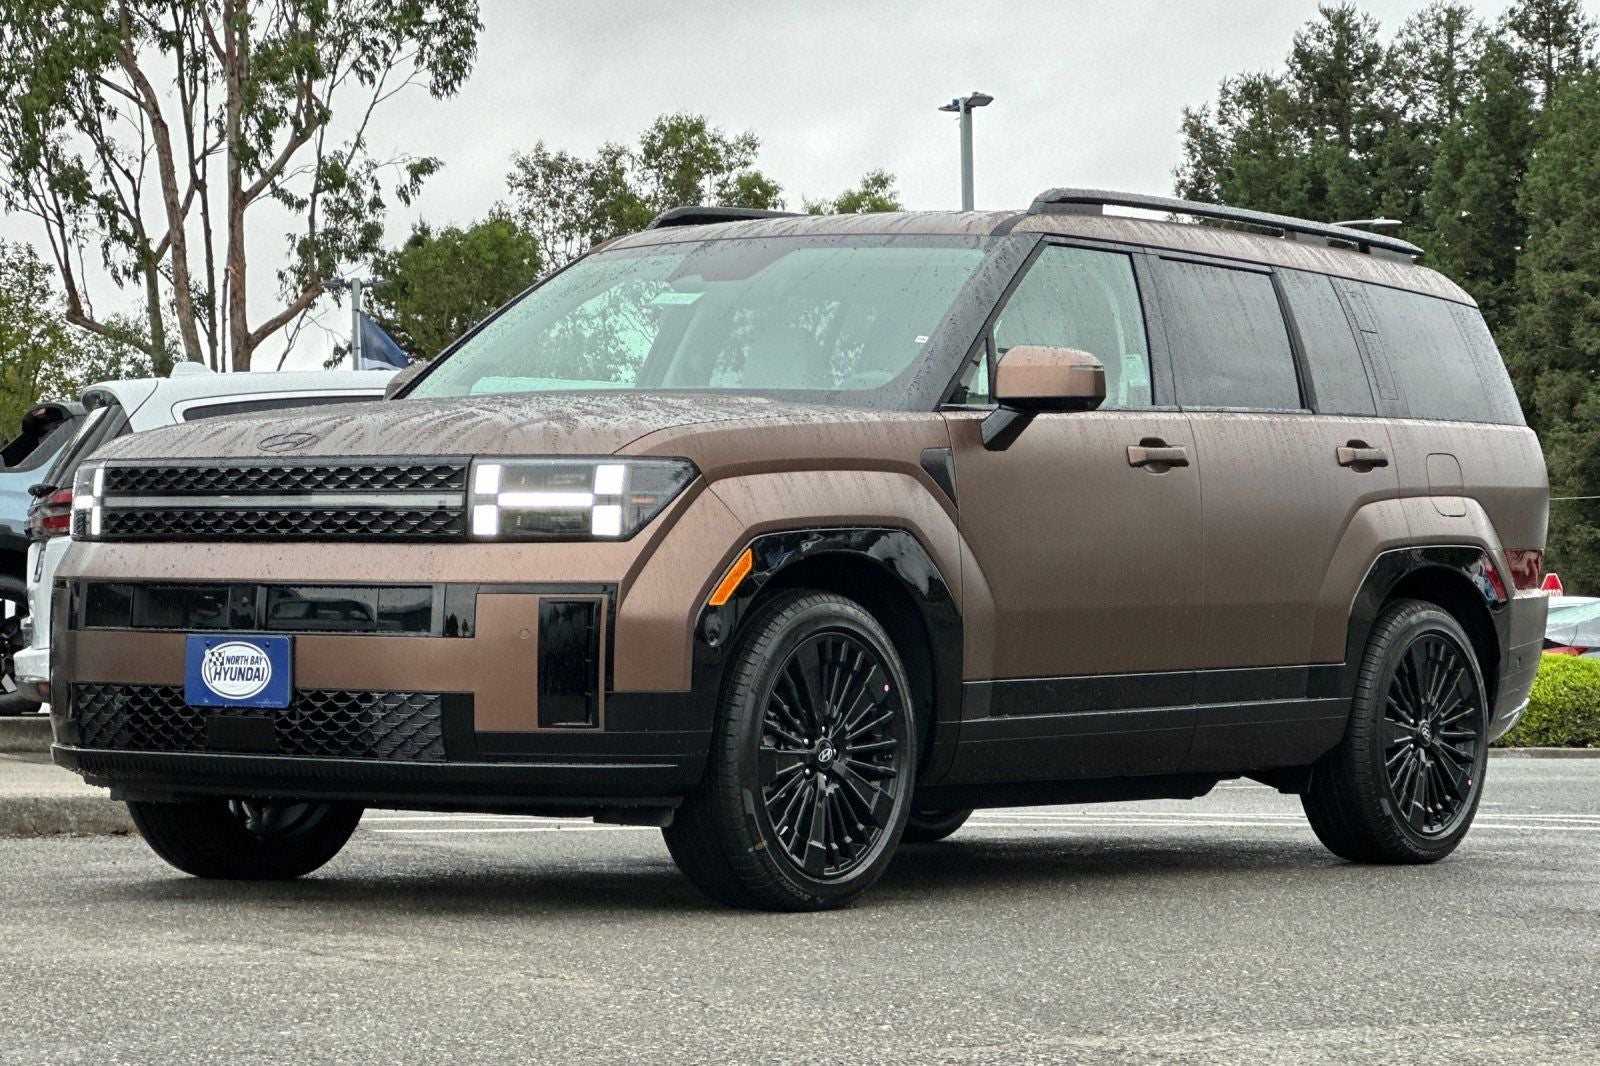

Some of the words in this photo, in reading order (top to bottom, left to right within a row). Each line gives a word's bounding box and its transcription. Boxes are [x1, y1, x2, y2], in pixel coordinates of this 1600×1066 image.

[225, 655, 248, 665] NORTH
[249, 655, 263, 665] BAY
[213, 667, 265, 682] HYUNDAI
